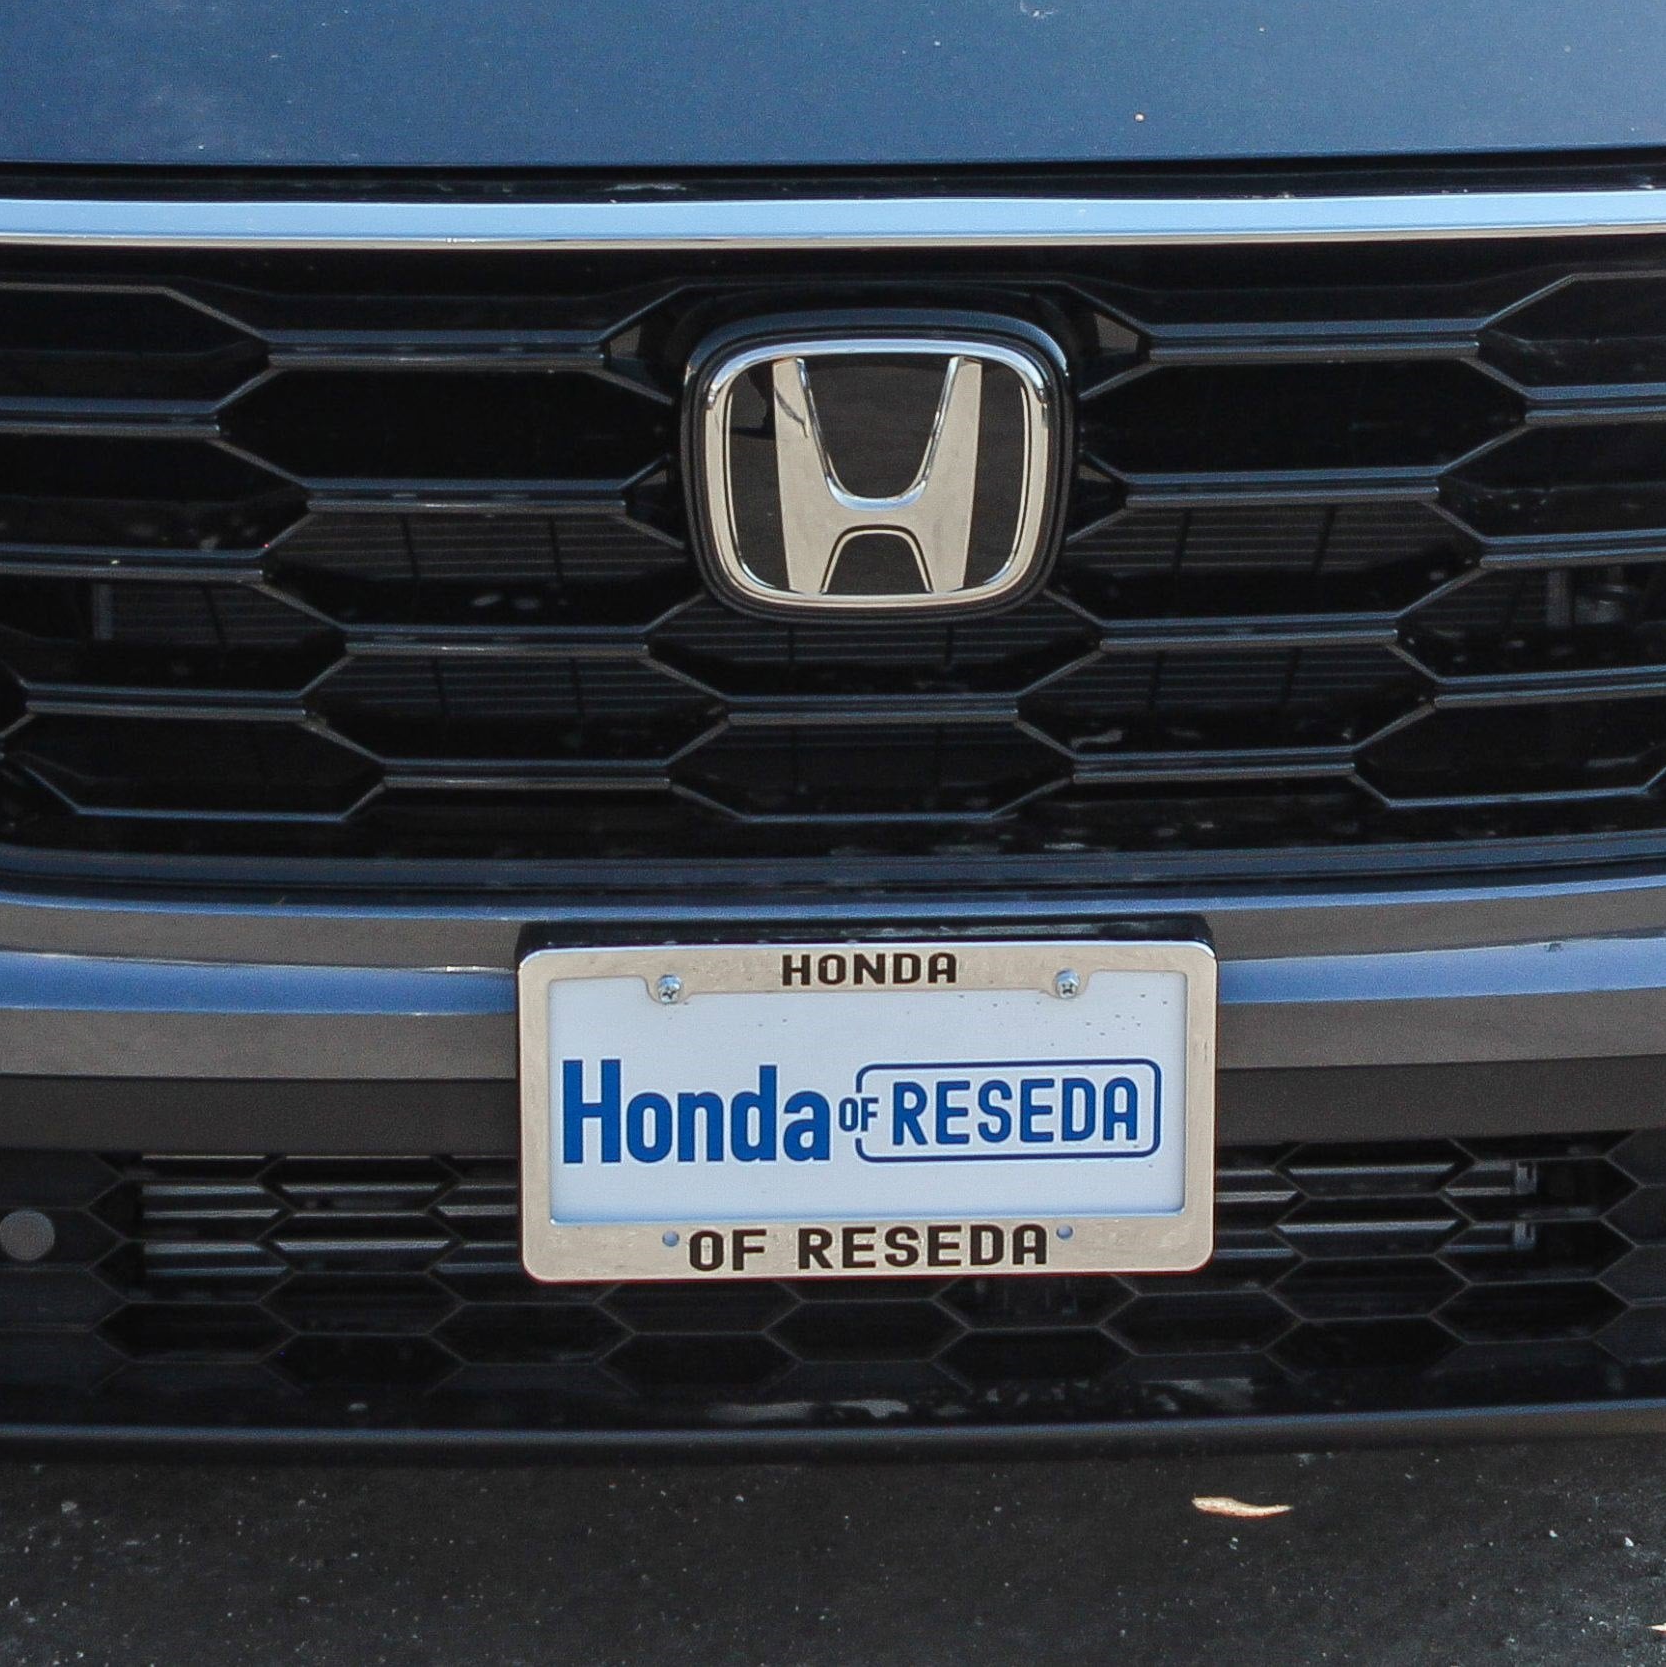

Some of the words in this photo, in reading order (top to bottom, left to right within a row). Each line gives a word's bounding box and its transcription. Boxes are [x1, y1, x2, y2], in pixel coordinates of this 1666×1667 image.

[781, 952, 959, 986] HONDA
[561, 1058, 832, 1164] Honda
[838, 1095, 879, 1134] OF
[891, 1076, 1140, 1147] RESEDA
[688, 1226, 767, 1272] OF
[797, 1222, 1049, 1270] RESEDA
